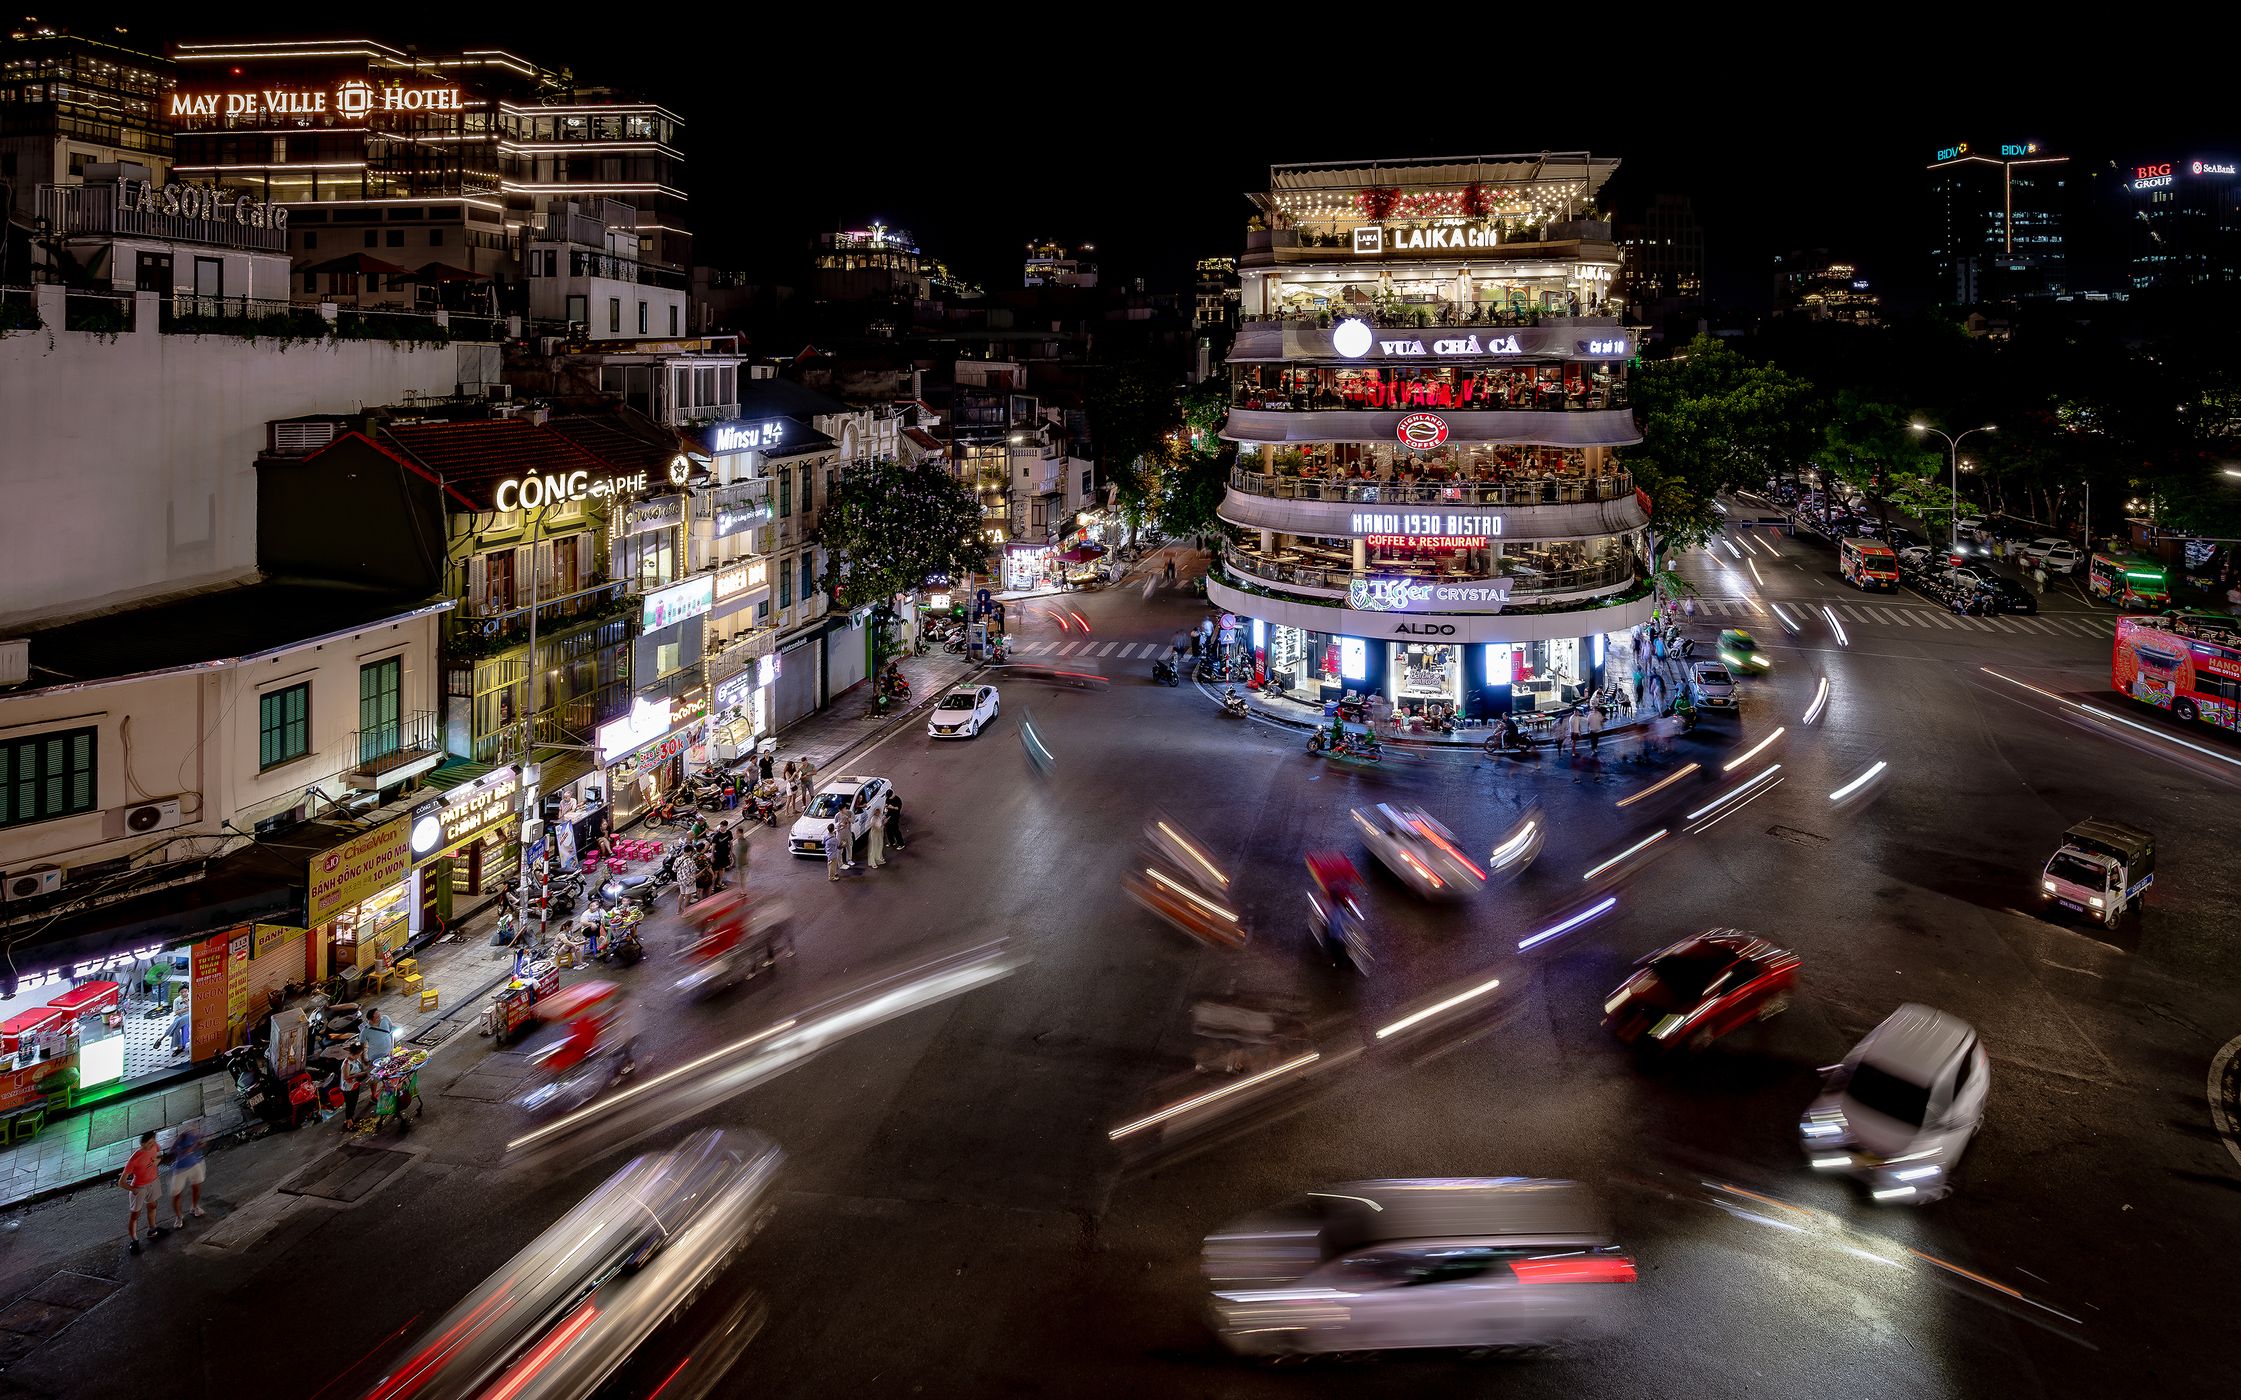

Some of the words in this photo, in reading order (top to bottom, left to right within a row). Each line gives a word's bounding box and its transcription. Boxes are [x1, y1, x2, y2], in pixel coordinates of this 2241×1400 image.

[170, 93, 221, 116] MAY
[227, 93, 257, 114] DE
[263, 90, 326, 113] VILLE
[383, 87, 463, 110] HOTEL
[1937, 147, 1959, 161] BIDV
[2001, 144, 2027, 156] BIDV
[2137, 163, 2171, 179] BRG
[2203, 163, 2236, 174] SeABank
[2134, 176, 2172, 189] GROUP
[118, 176, 155, 214] LA
[1358, 234, 1378, 242] LAIKA
[1395, 228, 1467, 249] LAIKA
[1574, 265, 1604, 281] LAIKA
[1379, 340, 1427, 356] VUA
[1433, 334, 1483, 355] CHẢ
[1488, 334, 1522, 354] CÁ
[1400, 415, 1446, 430] HIGHLANDS
[716, 427, 760, 451] Minsu
[1405, 439, 1441, 448] COFFEE
[1353, 513, 1399, 534] HANOI
[1404, 514, 1441, 535] 1930
[1447, 516, 1502, 536] BISTRO
[1368, 535, 1406, 546] COFFEE
[1408, 536, 1417, 546] &
[1419, 536, 1487, 547] RESTAURANT
[1370, 578, 1434, 609] Tiger
[1436, 588, 1510, 602] CRYSTAL
[1395, 623, 1456, 636] ALDO
[781, 636, 808, 654] Vietcombank
[2209, 658, 2241, 674] HANO
[416, 802, 431, 814] CÔNG
[447, 813, 482, 840] CHÍNH
[344, 829, 397, 860] CheeWon
[311, 876, 336, 898] BÁNH
[337, 865, 362, 884] ĐỒNG
[363, 862, 374, 873] XU
[376, 848, 393, 866] PHÔ
[394, 841, 410, 857] MAI
[373, 870, 383, 882] 10
[385, 858, 405, 876] WON
[234, 937, 248, 949] 113
[259, 929, 284, 945] BÁNH
